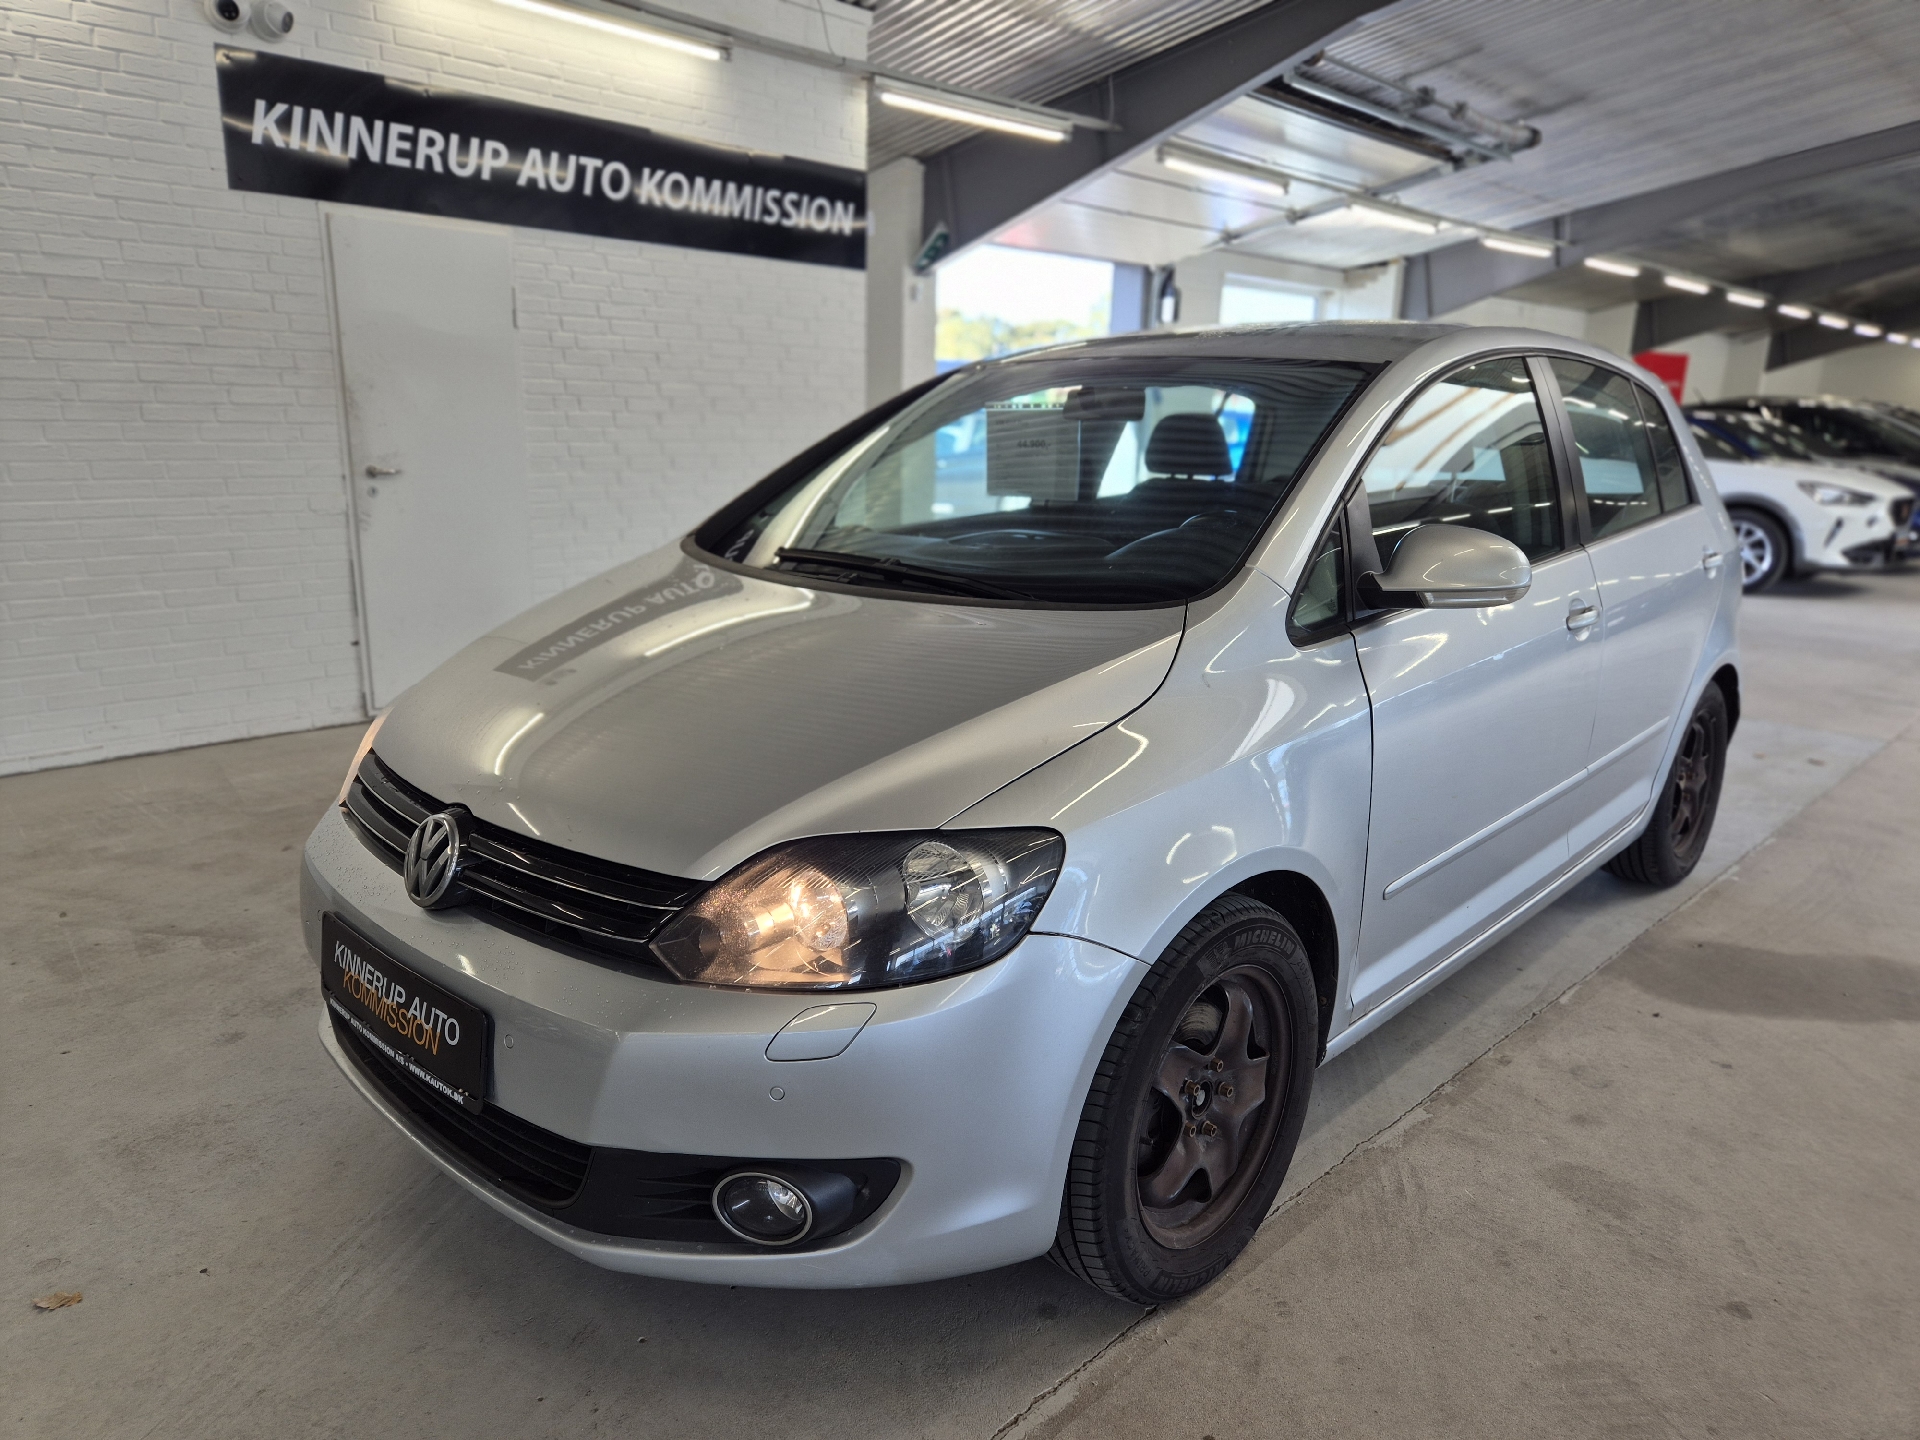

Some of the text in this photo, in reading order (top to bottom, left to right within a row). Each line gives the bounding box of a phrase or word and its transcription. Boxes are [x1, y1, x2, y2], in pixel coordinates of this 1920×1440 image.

[251, 98, 856, 236] KINNERUP AUTO KOMMISSION
[1233, 929, 1295, 956] MICHELIN
[334, 940, 460, 1046] KINNERUP AUTO
[343, 969, 441, 1056] KOMMISSION
[350, 1017, 363, 1033] AUTO
